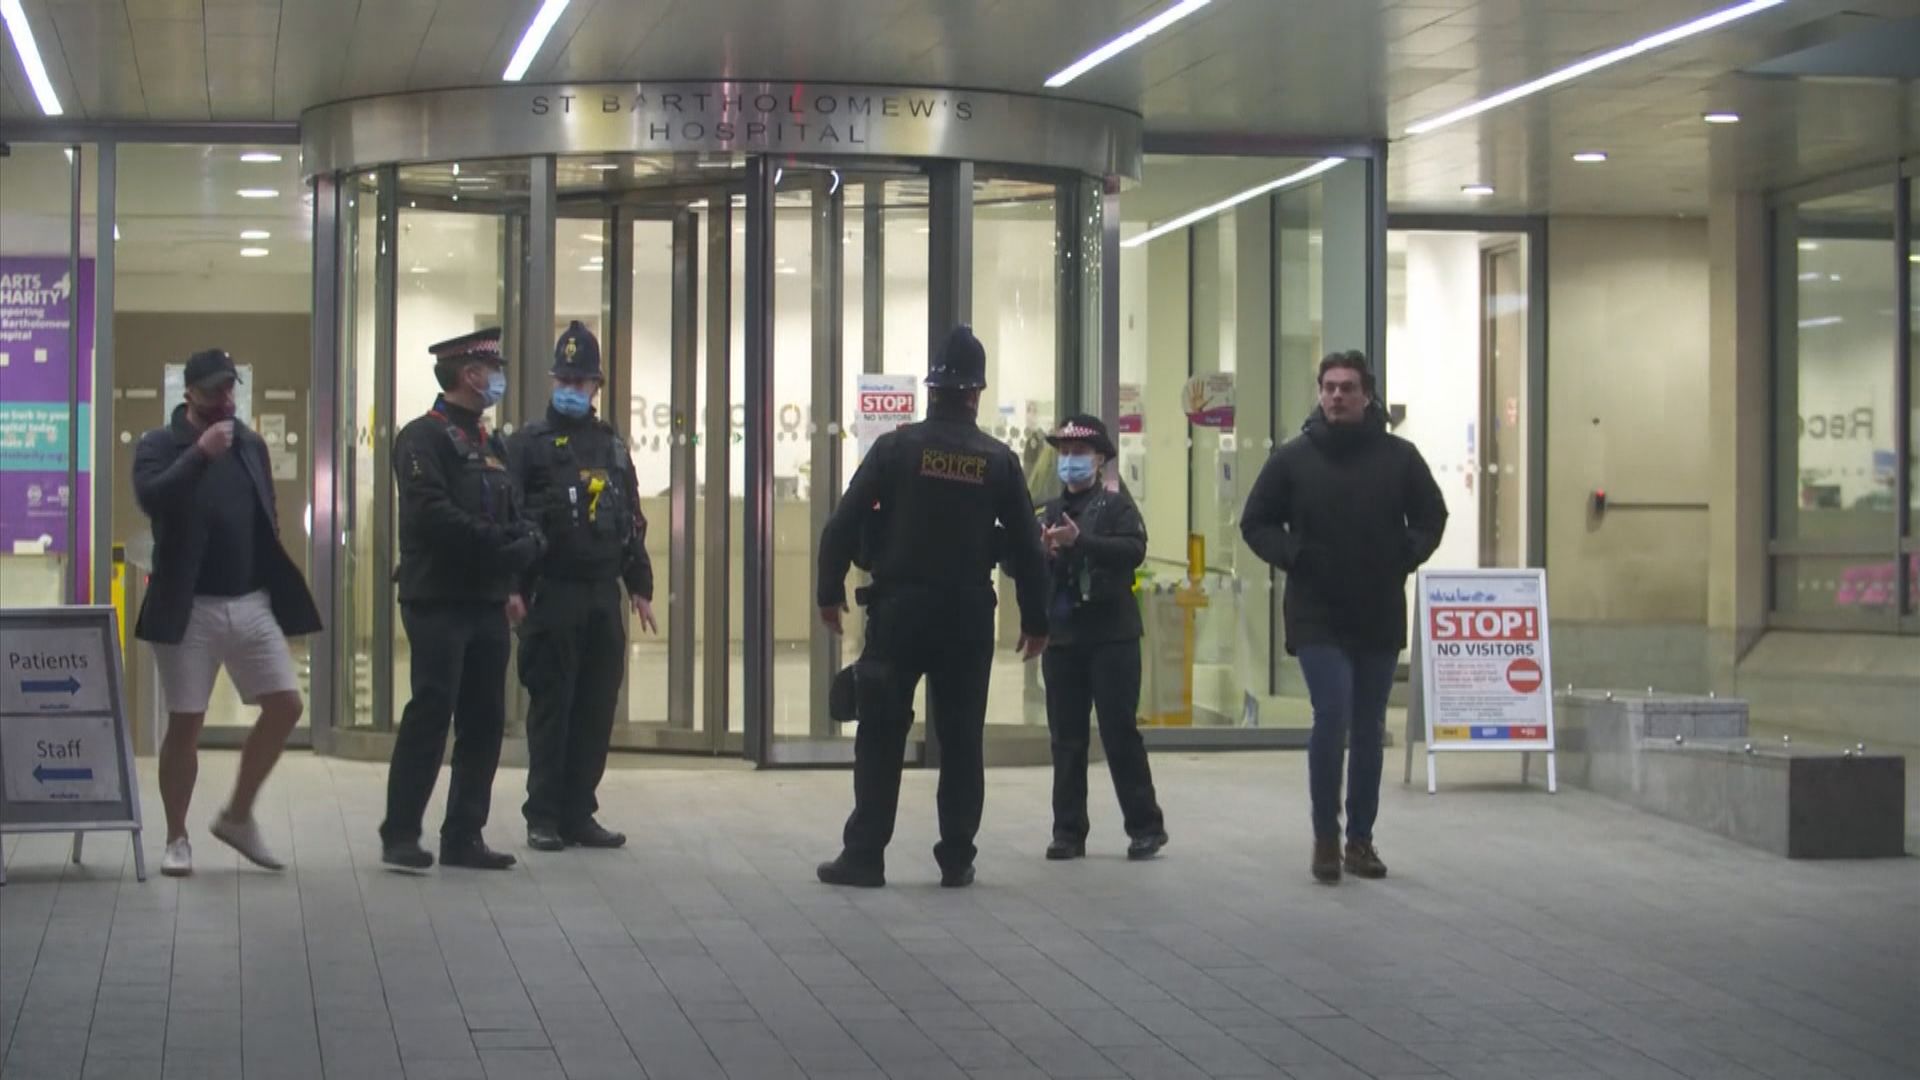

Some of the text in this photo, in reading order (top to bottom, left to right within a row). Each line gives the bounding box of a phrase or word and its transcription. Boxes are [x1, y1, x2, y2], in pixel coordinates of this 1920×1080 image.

[531, 92, 973, 121] ST BARTHOLOMEW'S
[650, 121, 865, 144] HOSPITAL
[0, 273, 41, 289] ARTS
[0, 290, 60, 305] HARITY
[863, 396, 913, 411] STOP!
[922, 455, 985, 479] POLICE
[1436, 610, 1534, 637] STOP!
[1437, 643, 1535, 656] NO VISITORS
[9, 652, 88, 670] Patients
[36, 739, 82, 759] Staff
